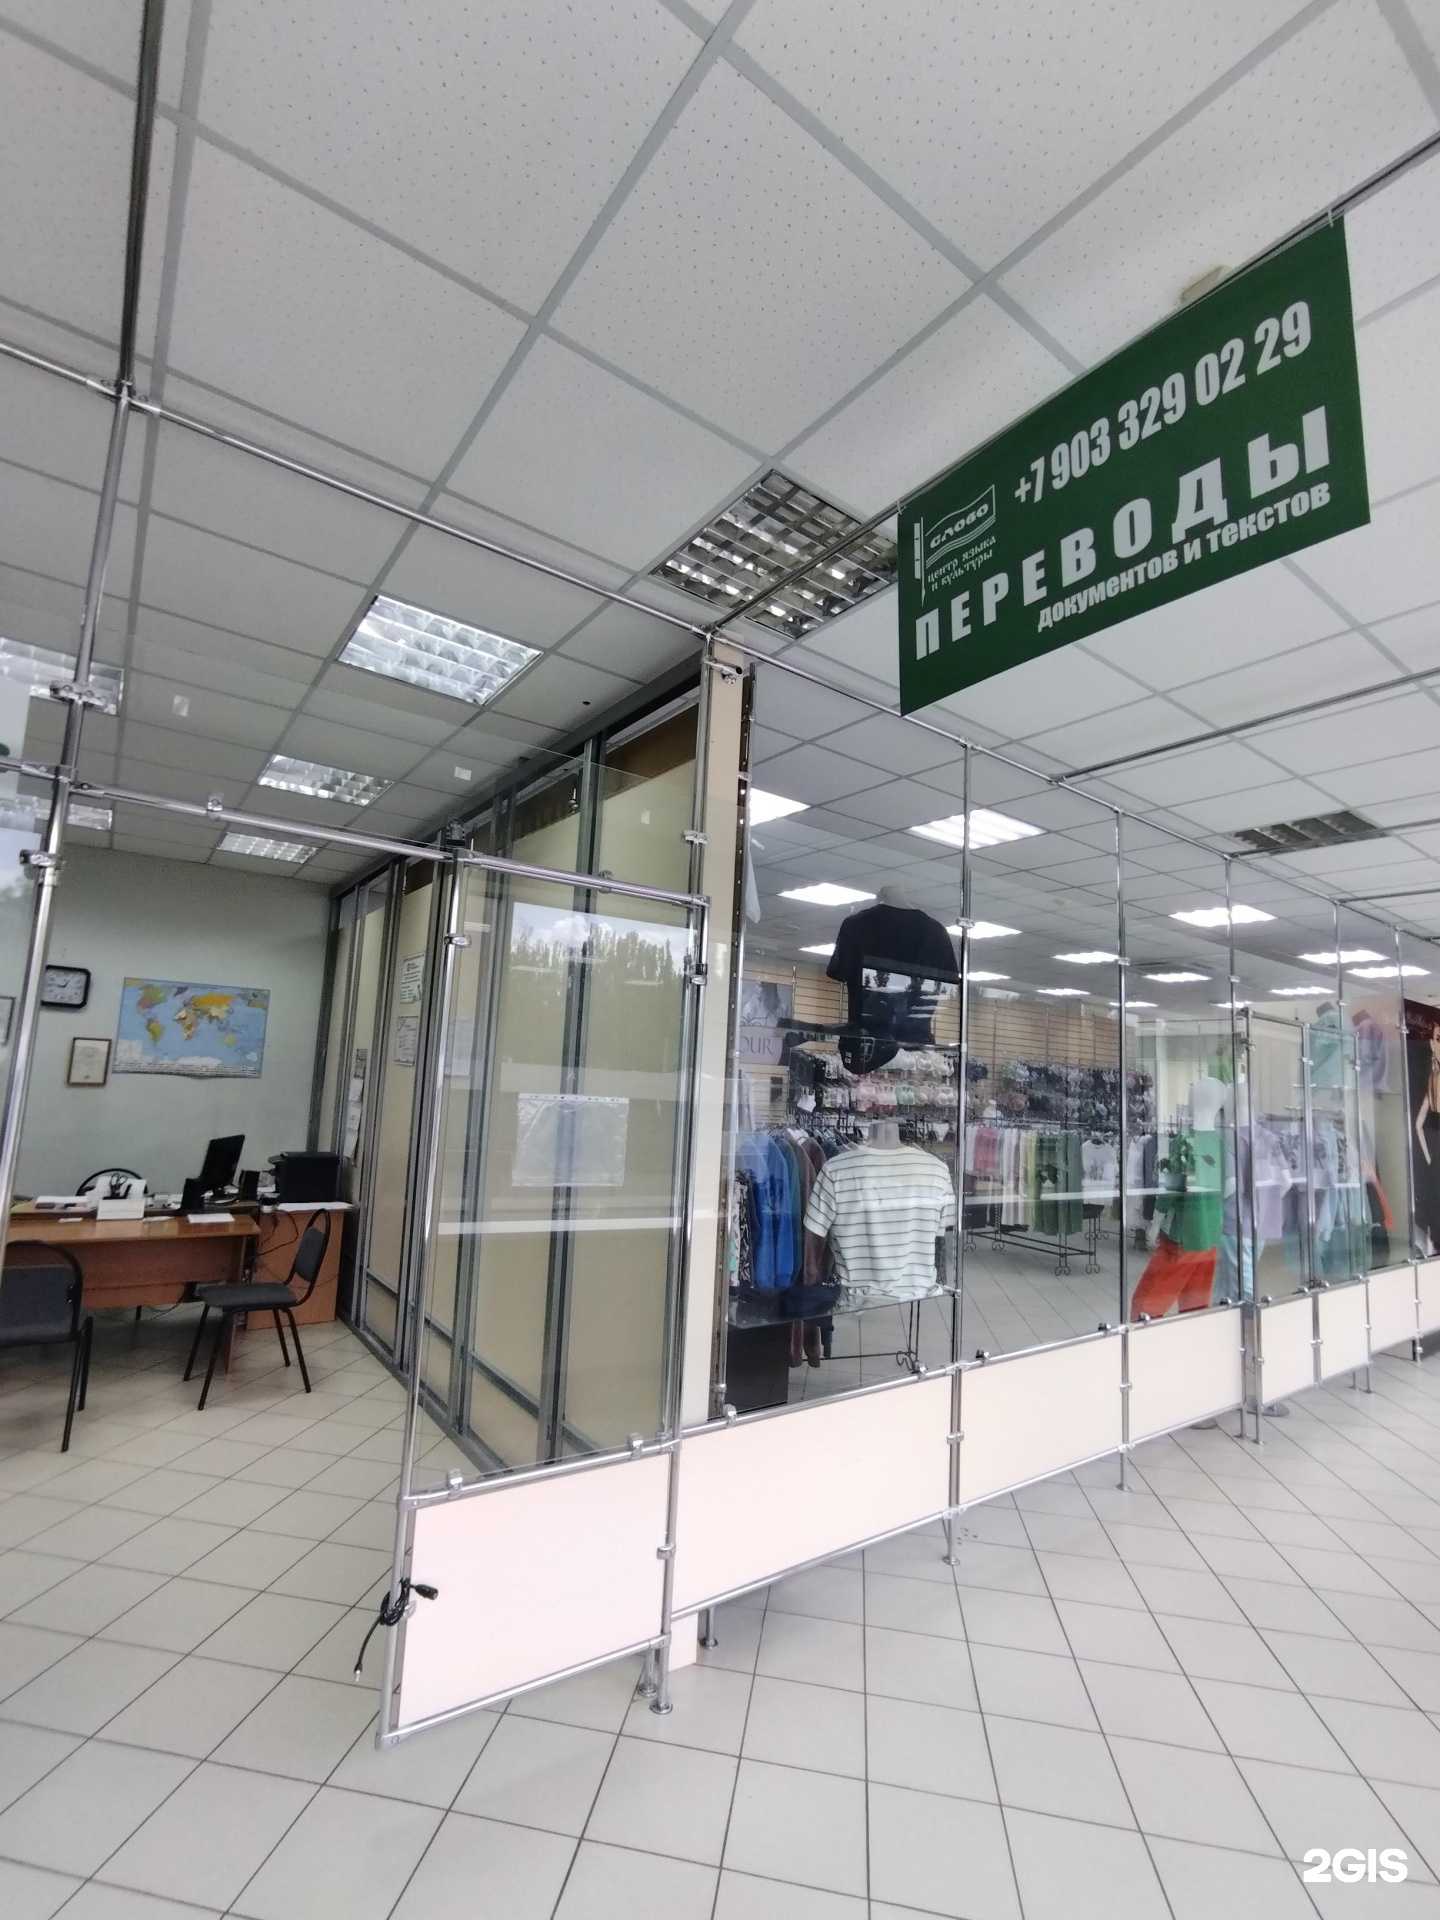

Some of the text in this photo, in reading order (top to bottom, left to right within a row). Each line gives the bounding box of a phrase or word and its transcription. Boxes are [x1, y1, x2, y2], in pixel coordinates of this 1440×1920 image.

[1014, 301, 1312, 504] +7 903 329 02 29
[915, 405, 1330, 660] ПЕРЕВОДЫ
[940, 549, 993, 586] культуры
[961, 535, 997, 562] языка
[1037, 482, 1332, 633] документов и текстов
